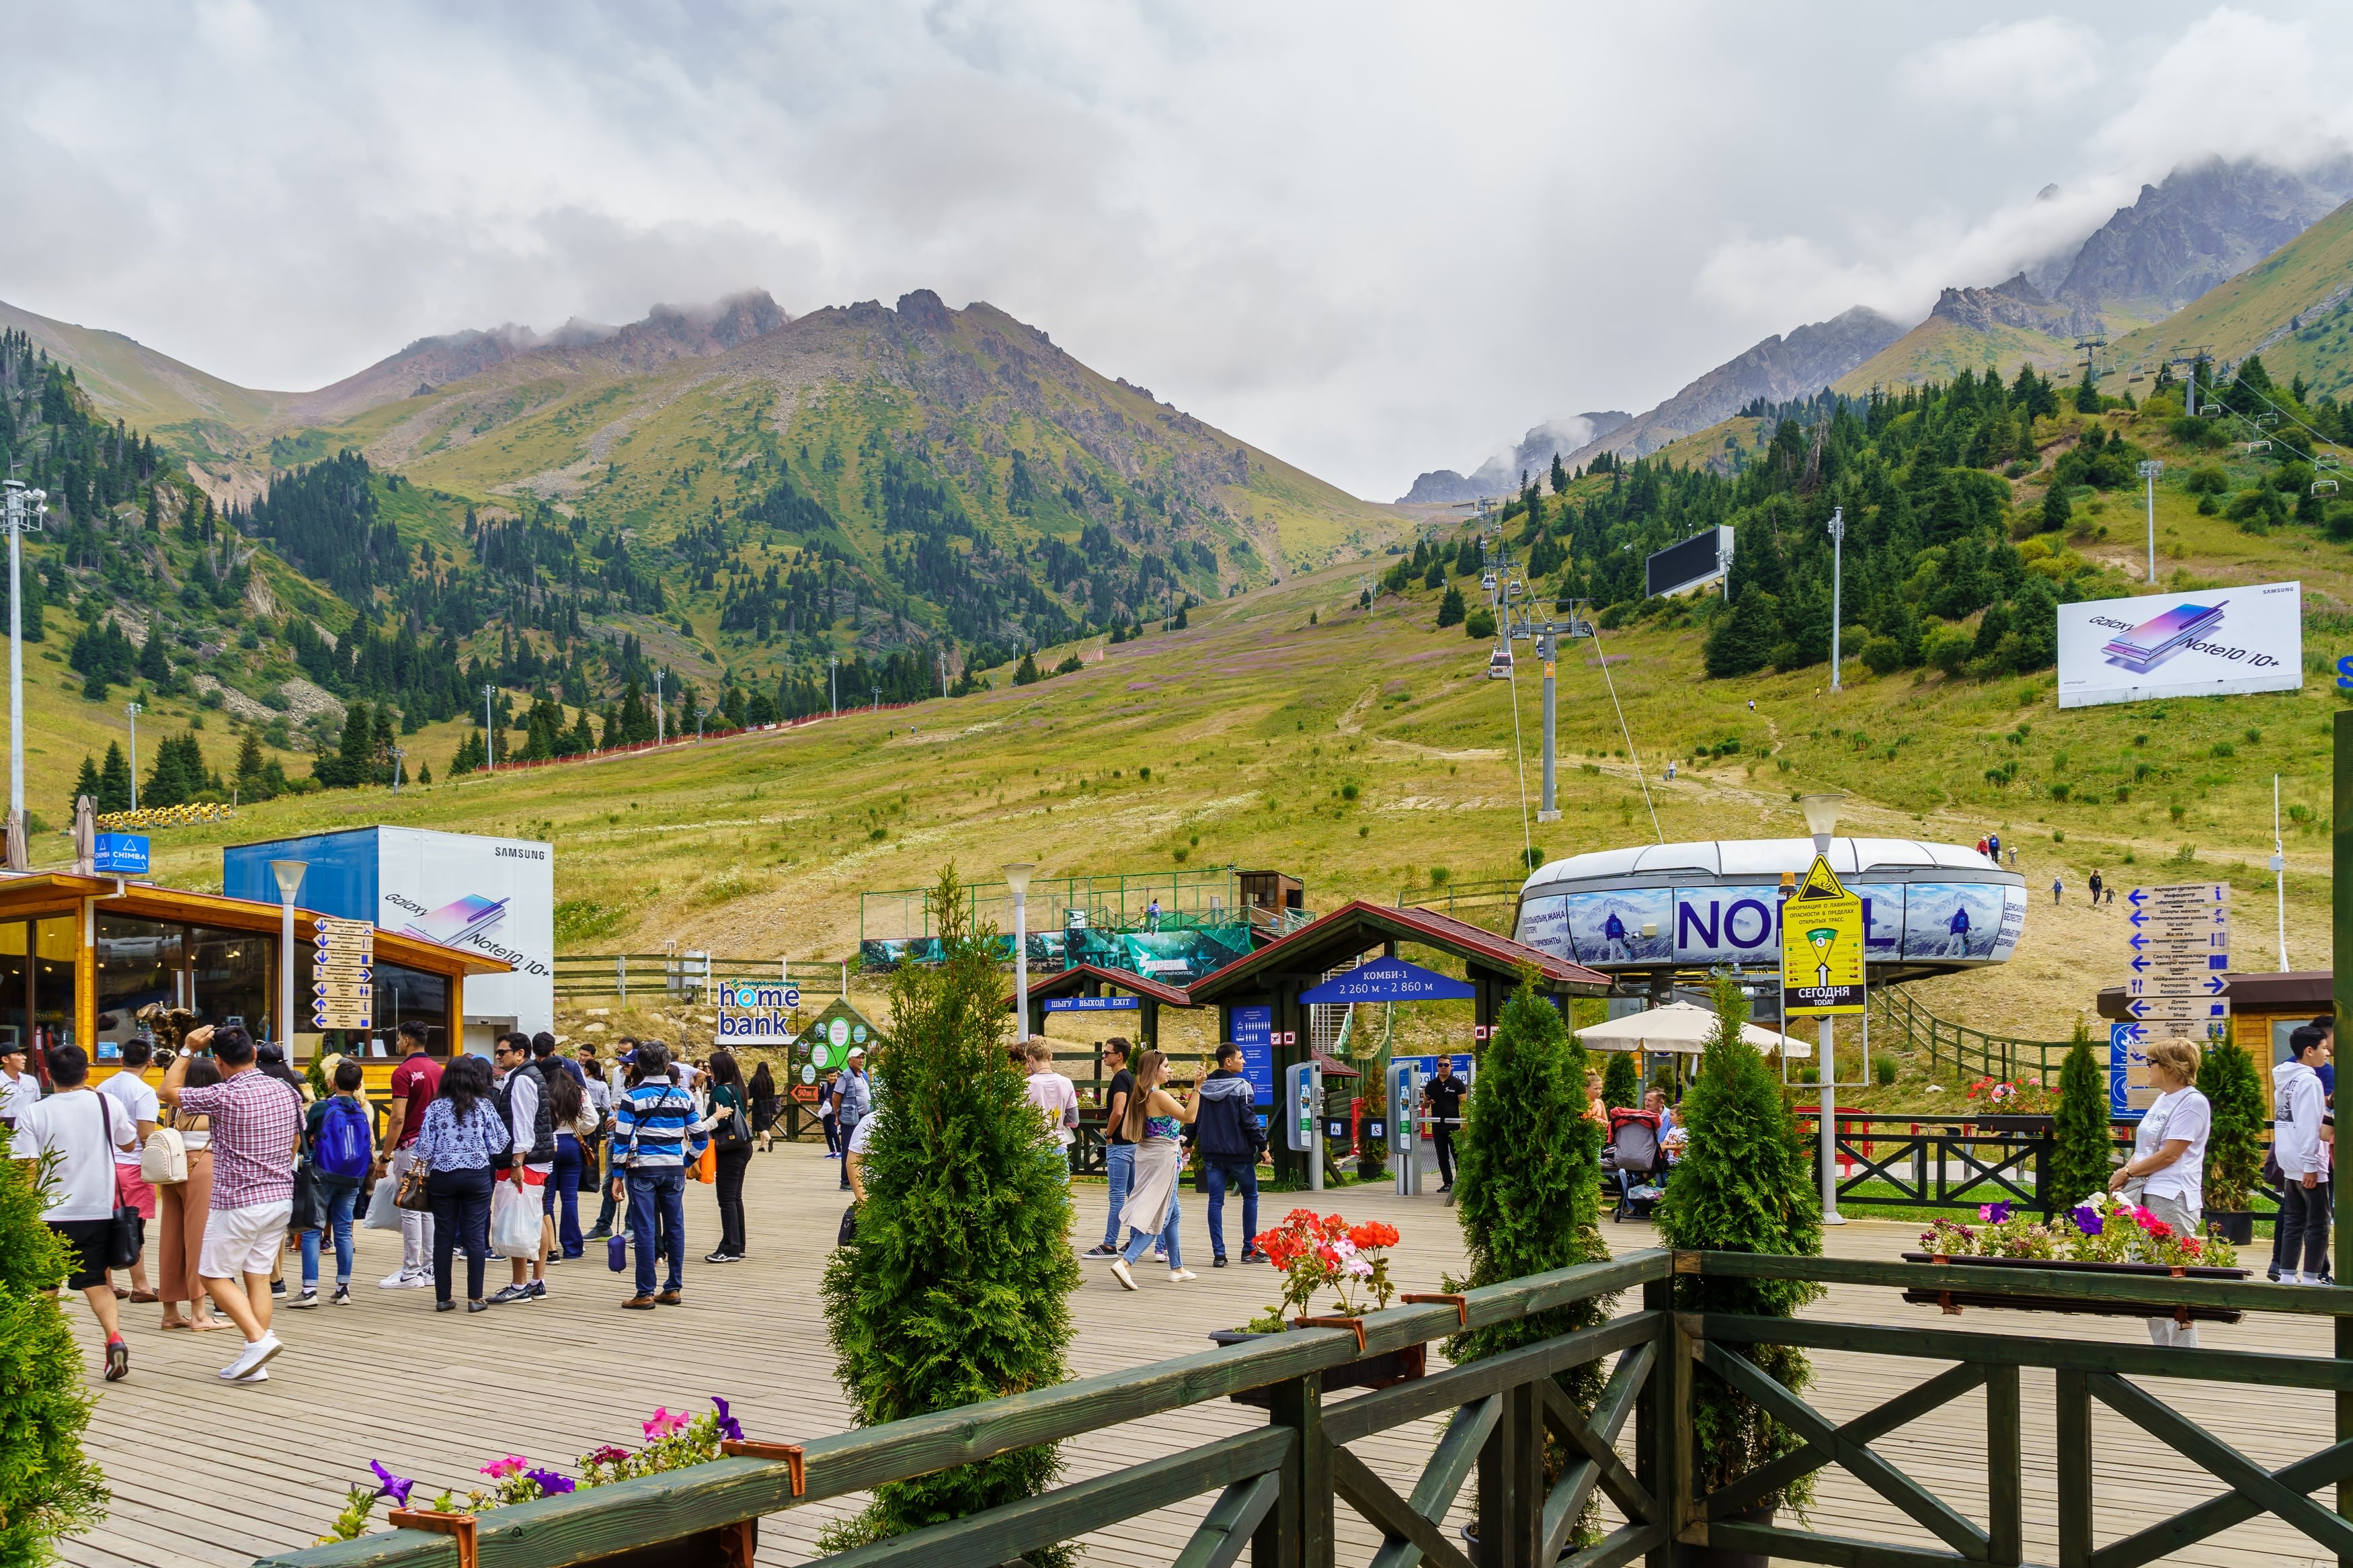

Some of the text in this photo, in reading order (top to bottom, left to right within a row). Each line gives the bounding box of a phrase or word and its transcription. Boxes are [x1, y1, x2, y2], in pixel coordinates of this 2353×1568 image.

[2263, 587, 2294, 595] SAMSUNG
[2089, 616, 2135, 633] Galaxy
[112, 851, 147, 861] CHIMBA
[495, 847, 545, 860] SAMSUNG
[385, 893, 430, 917] Galaxy
[1547, 910, 1565, 921] ЖАҢА
[1678, 898, 1896, 949] NOL
[1363, 971, 1408, 980] КОМБИ-1
[1339, 985, 1345, 994] 2
[1349, 983, 1368, 993] 260
[1391, 983, 1397, 992] 2
[1401, 981, 1421, 991] 860
[1798, 986, 1849, 999] СЕГОДНЯ
[719, 982, 800, 1008] home
[1079, 999, 1105, 1007] ВЫХОД
[719, 1011, 789, 1036] bank
[1301, 1083, 1310, 1095] 5%
[1400, 1085, 1409, 1096] 5%
